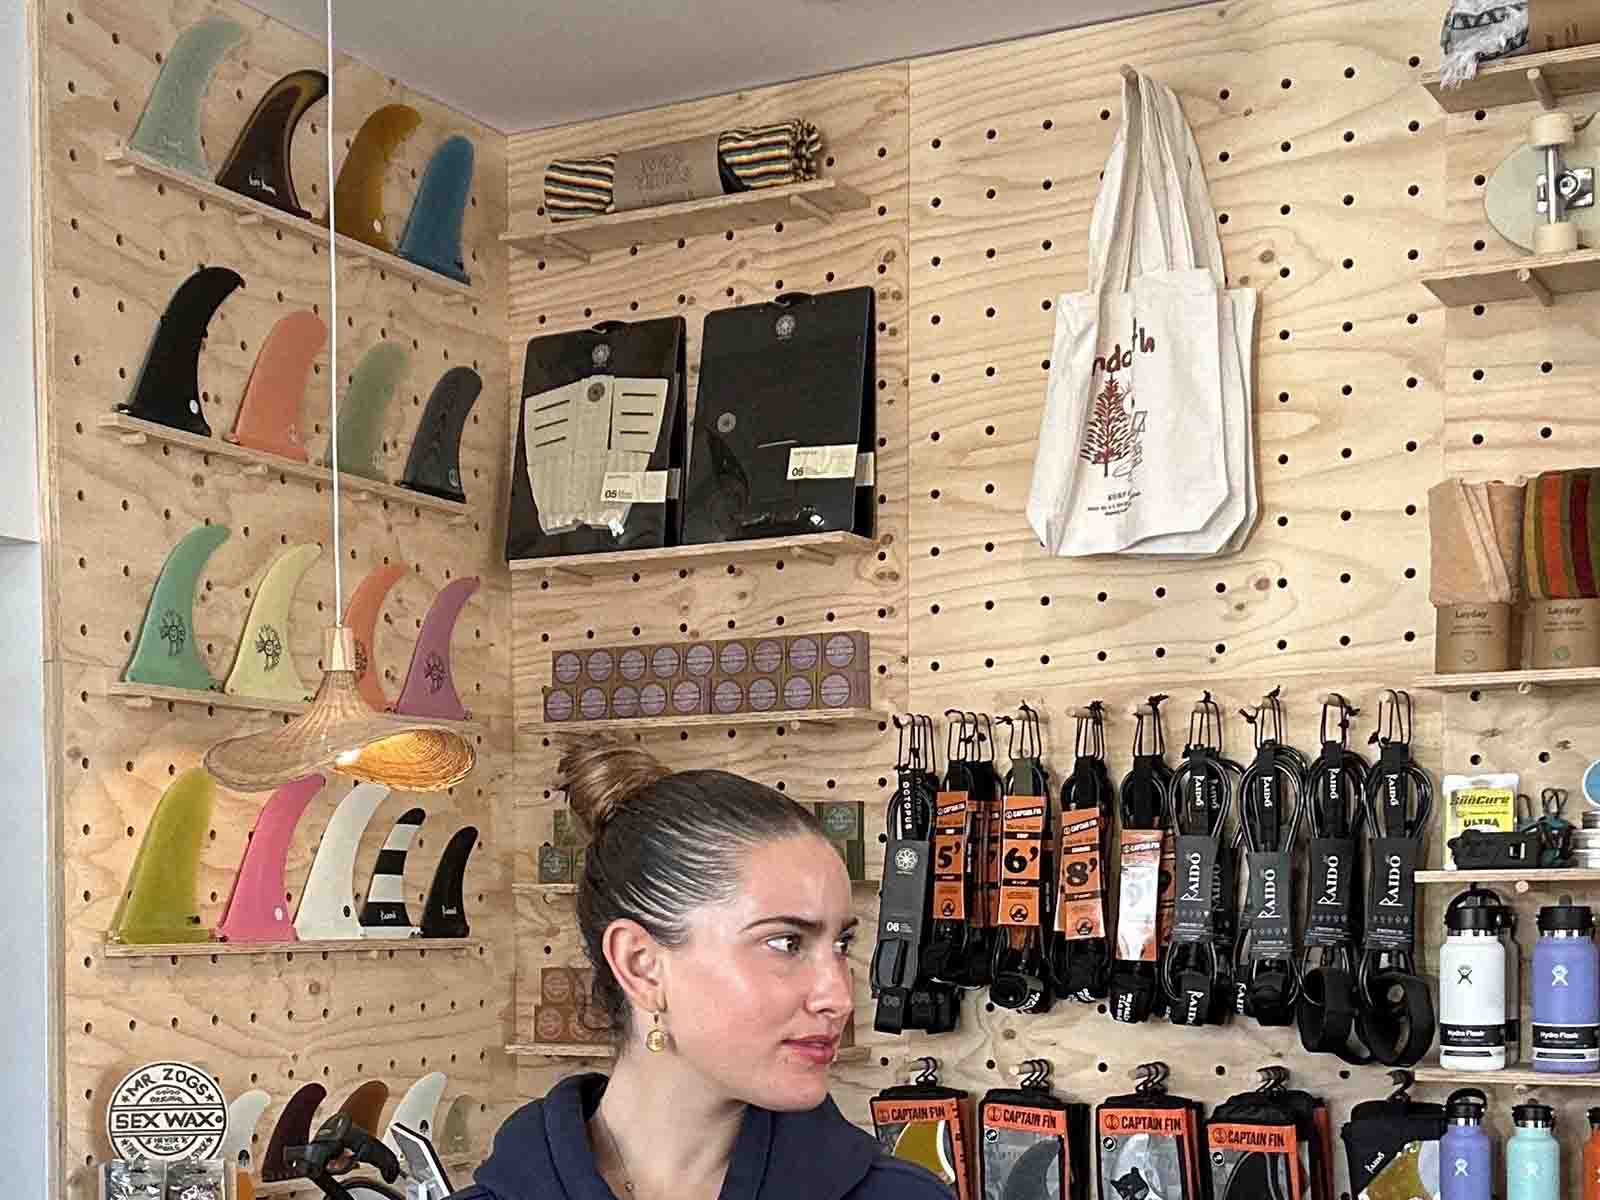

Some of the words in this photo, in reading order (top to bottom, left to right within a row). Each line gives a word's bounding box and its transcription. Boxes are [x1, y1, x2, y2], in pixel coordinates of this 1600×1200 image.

[902, 781, 913, 830] OCTOPUS
[1004, 846, 1039, 873] 6'
[1066, 857, 1097, 887] 8'
[126, 1073, 157, 1096] MR
[162, 1068, 209, 1096] ZOGS
[891, 1106, 927, 1121] CAPTAIN
[929, 1105, 945, 1118] FIN
[1003, 1110, 1040, 1126] CAPTAIN
[1042, 1112, 1056, 1128] FIN
[1121, 1116, 1162, 1130] CAPTAIN
[1165, 1116, 1181, 1130] FIN
[1226, 1131, 1266, 1145] CAPTAIN
[1268, 1133, 1285, 1146] FIN
